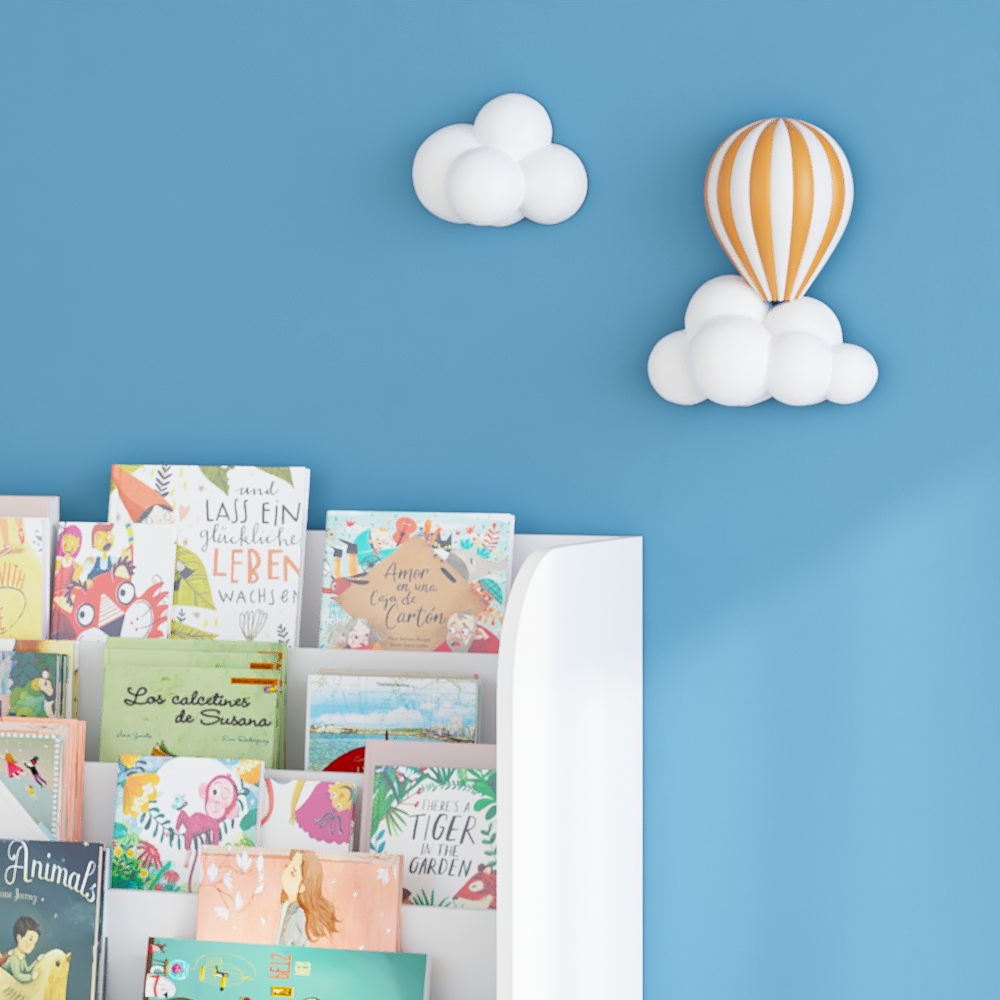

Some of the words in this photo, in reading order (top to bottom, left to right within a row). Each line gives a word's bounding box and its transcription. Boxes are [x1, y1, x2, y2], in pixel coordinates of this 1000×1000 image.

[234, 481, 279, 496] und
[205, 498, 248, 523] LASS
[383, 561, 430, 583] Amor
[414, 582, 439, 593] una
[369, 589, 398, 611] Caja
[401, 591, 417, 606] de
[384, 603, 447, 630] Cartón
[123, 686, 166, 707] Los
[171, 690, 251, 709] calcetines
[175, 709, 195, 724] de
[199, 708, 272, 727] Susana
[421, 799, 459, 814] THERE'S
[463, 801, 471, 813] A
[409, 813, 477, 845] TIGER
[421, 843, 433, 855] IN
[438, 843, 459, 857] THE
[4, 838, 98, 903] Animals
[408, 857, 473, 877] GARDEN
